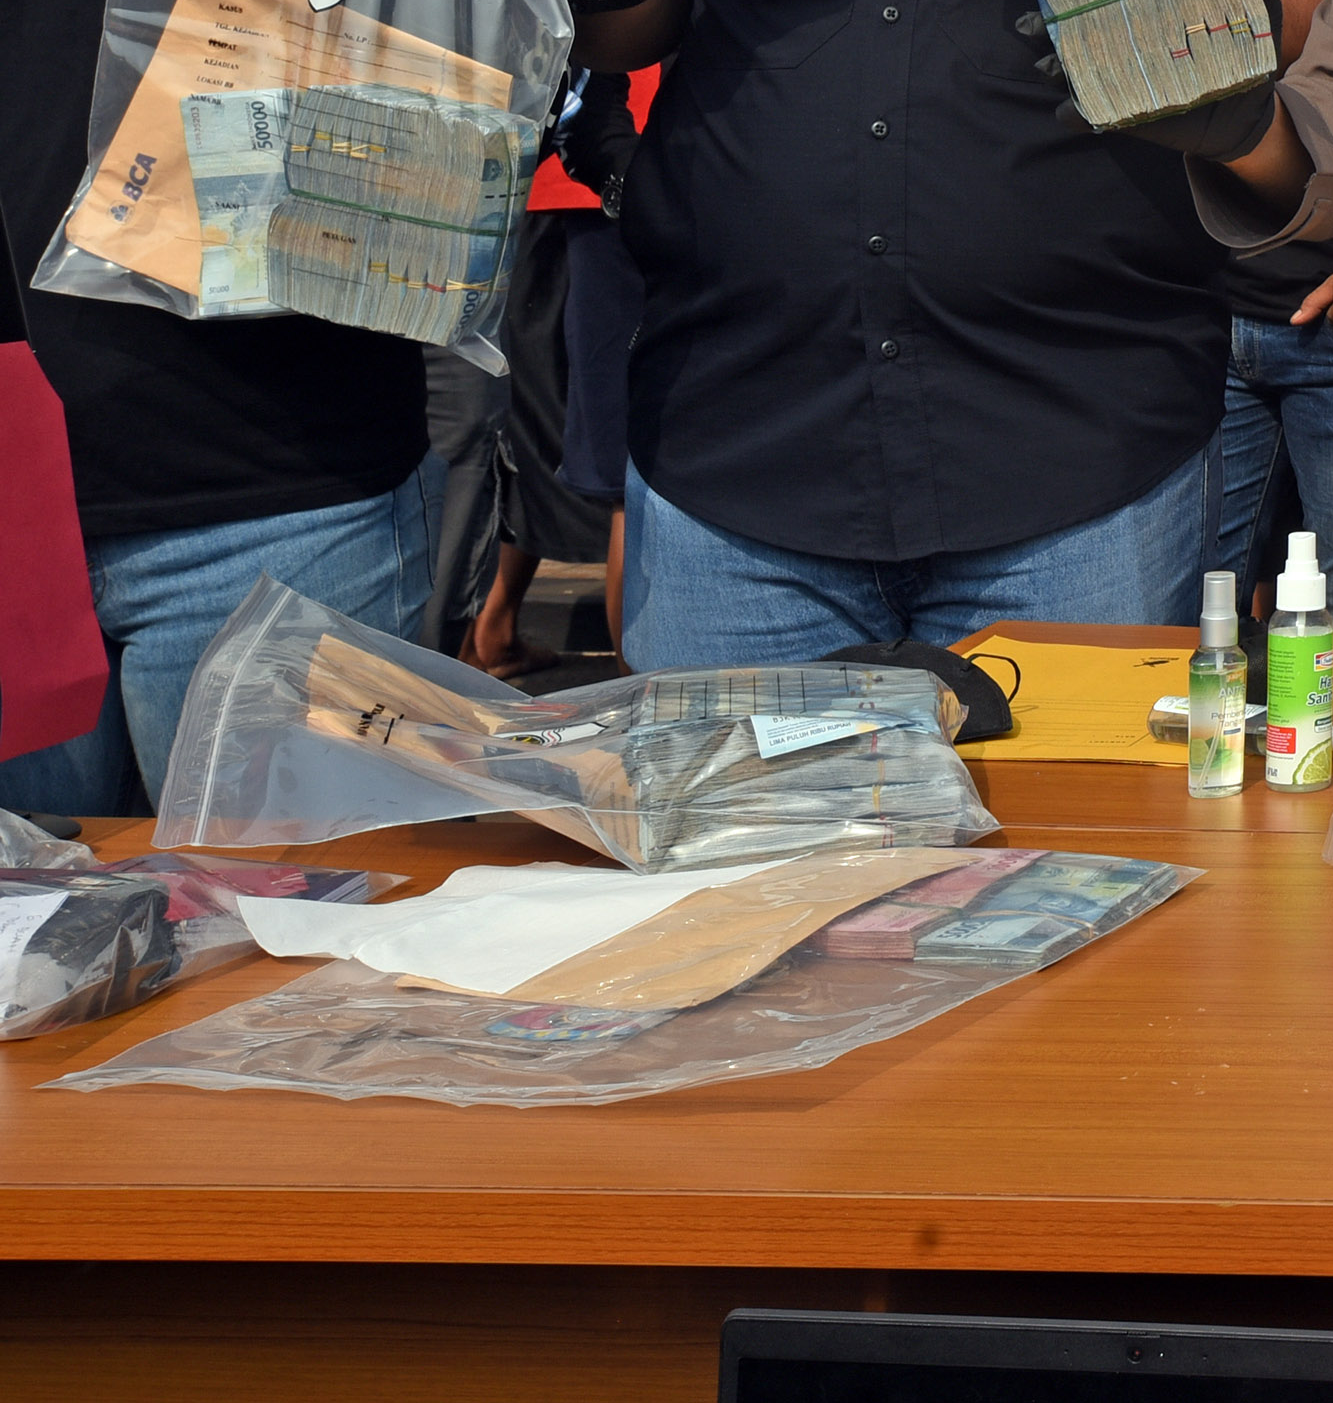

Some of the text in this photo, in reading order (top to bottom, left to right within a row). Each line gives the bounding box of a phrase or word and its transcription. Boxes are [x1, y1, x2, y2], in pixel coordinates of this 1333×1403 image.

[250, 100, 274, 150] 50000
[121, 152, 158, 202] BCA
[1319, 675, 1333, 691] Ha
